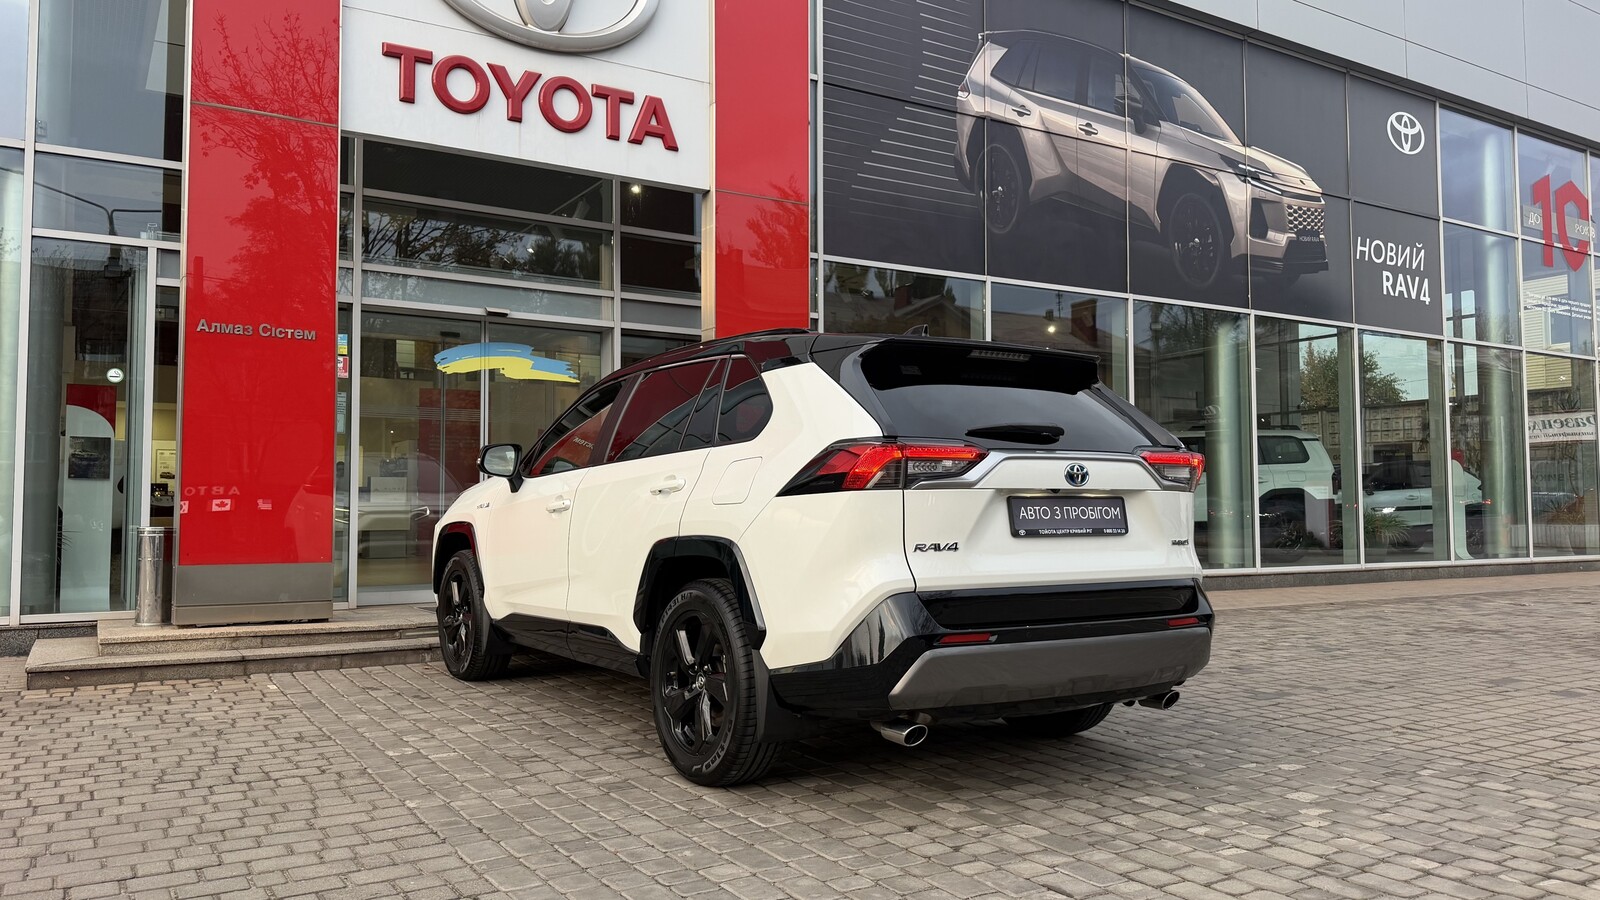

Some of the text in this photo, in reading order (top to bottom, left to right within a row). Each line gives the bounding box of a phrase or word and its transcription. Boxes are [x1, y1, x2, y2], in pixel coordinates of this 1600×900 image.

[381, 42, 679, 152] TOYOTA
[1356, 236, 1426, 272] НОВИЙ
[1382, 271, 1431, 306] RAV4
[196, 318, 317, 341] Алмаз Сістем
[1019, 506, 1051, 520] АВТО
[1063, 505, 1121, 520] ПРОБІГОМ
[913, 542, 959, 553] RAV4
